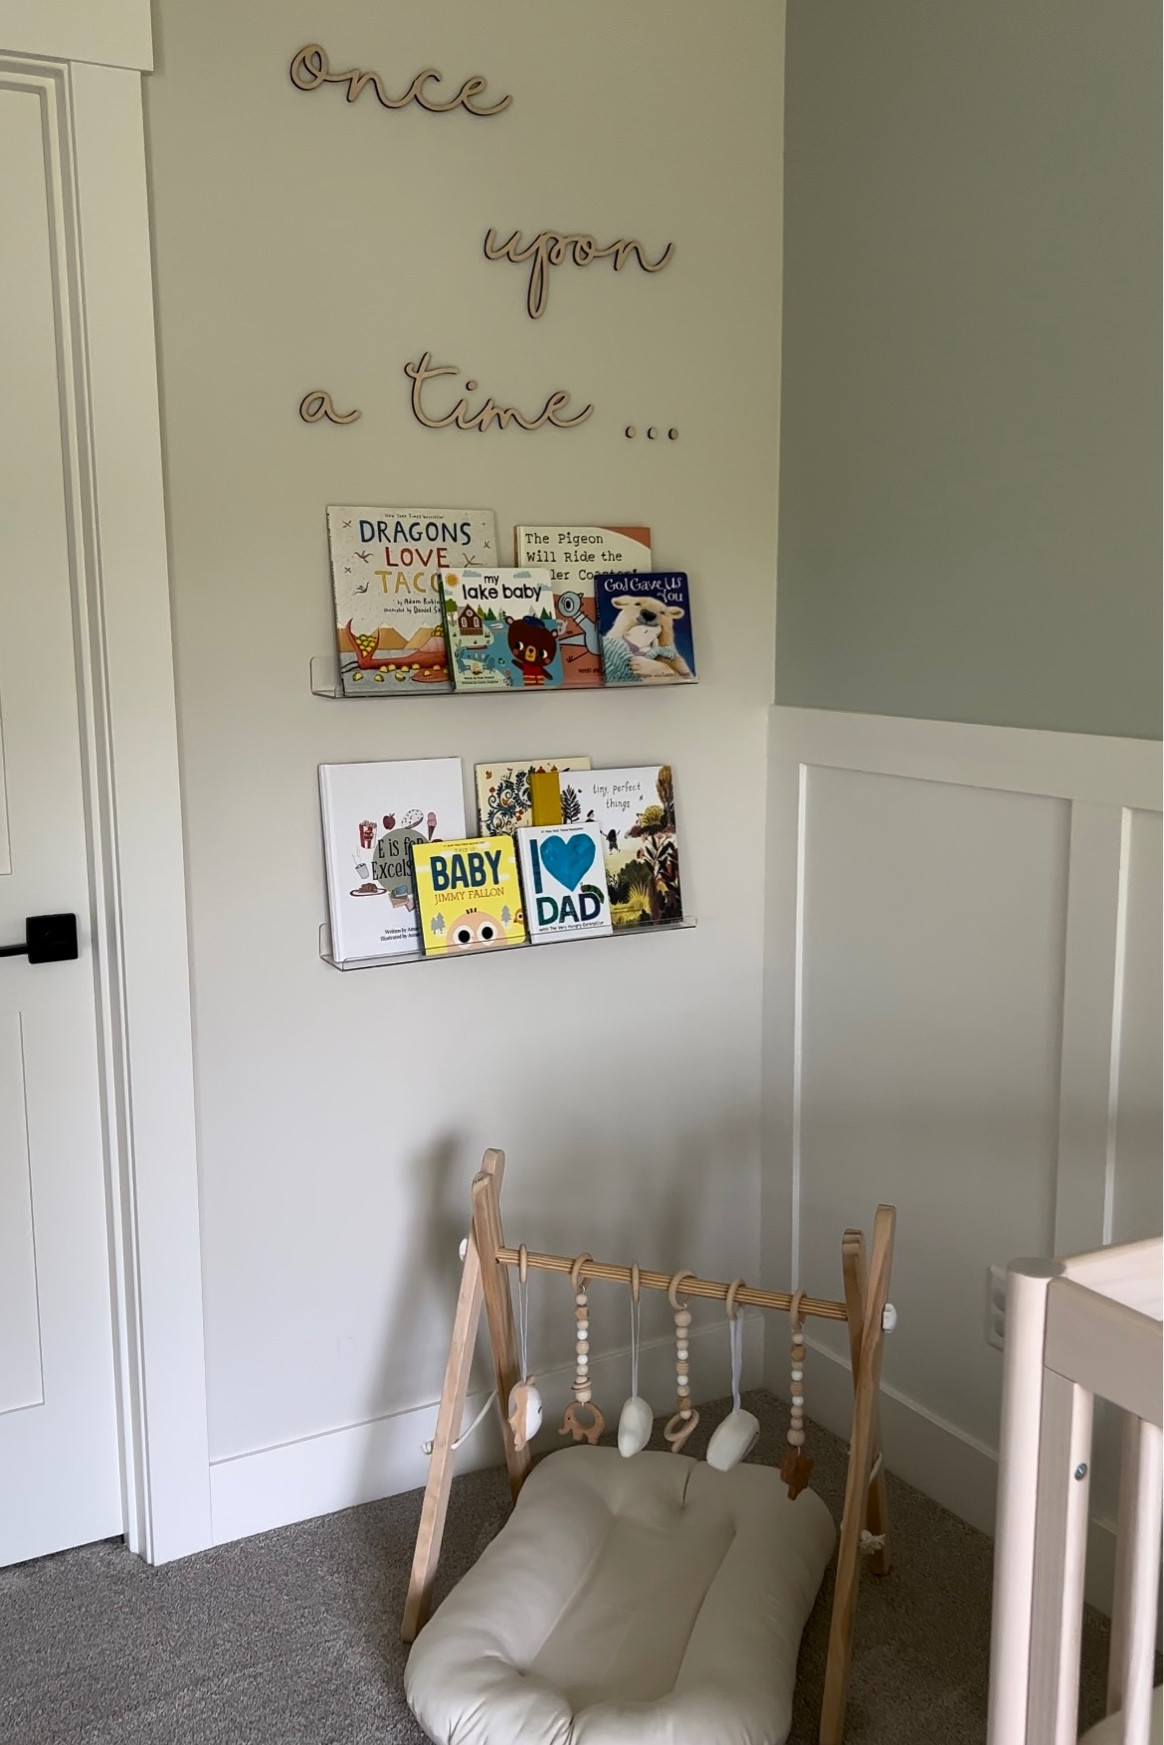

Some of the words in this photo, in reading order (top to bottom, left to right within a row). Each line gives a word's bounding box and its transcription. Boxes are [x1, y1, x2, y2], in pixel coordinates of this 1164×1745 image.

[290, 43, 513, 116] once
[483, 228, 675, 320] upon
[299, 390, 362, 425] a
[404, 351, 594, 432] time
[359, 520, 472, 546] DRAGONS
[525, 533, 550, 544] The
[558, 532, 604, 547] Pigeon
[385, 546, 450, 568] LOVE
[526, 550, 557, 562] Will
[564, 550, 596, 562] Ride
[601, 550, 623, 562] the
[374, 570, 440, 594] TACO
[484, 575, 500, 586] my
[550, 568, 570, 580] ler
[462, 584, 499, 600] lake
[502, 584, 541, 602] baby
[604, 577, 629, 592] God
[630, 577, 663, 591] Gave
[664, 577, 682, 590] Us
[657, 589, 683, 602] You
[612, 780, 641, 795] perfect
[606, 798, 630, 812] things
[378, 839, 385, 858] E
[389, 839, 399, 856] is
[371, 859, 412, 880] Excels
[430, 849, 502, 891] BABY
[529, 838, 543, 894] I
[434, 891, 465, 905] JIMMY
[468, 887, 504, 899] FALLON
[536, 892, 601, 927] DAD
